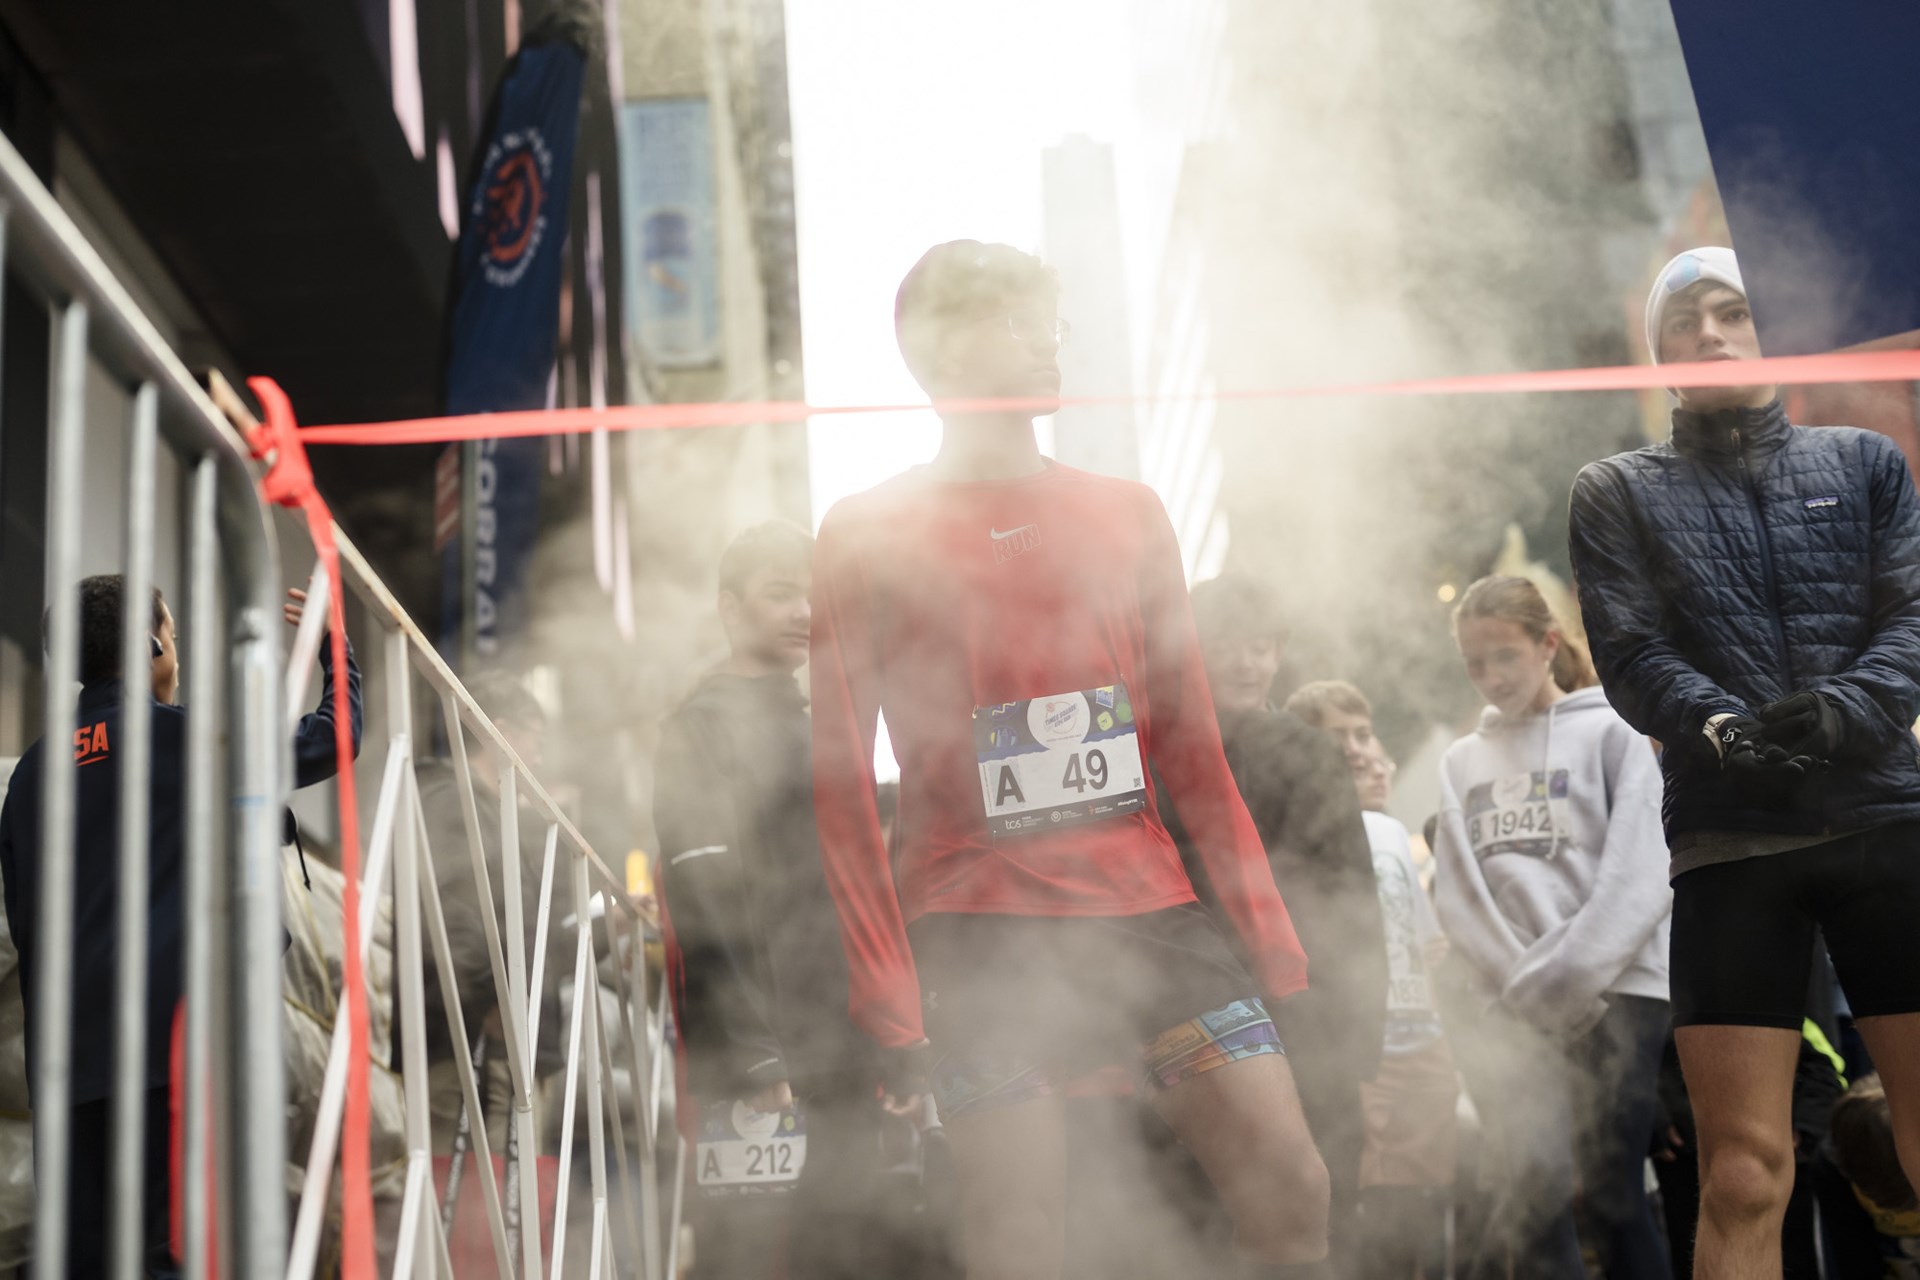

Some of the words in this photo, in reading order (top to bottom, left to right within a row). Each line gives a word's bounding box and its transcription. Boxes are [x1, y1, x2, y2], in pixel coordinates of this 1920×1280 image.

[996, 765, 1026, 807] A
[1062, 748, 1109, 793] 49
[1005, 819, 1022, 830] tcs
[1490, 805, 1553, 837] 1942
[703, 1148, 722, 1179] A
[745, 1143, 792, 1175] 212
